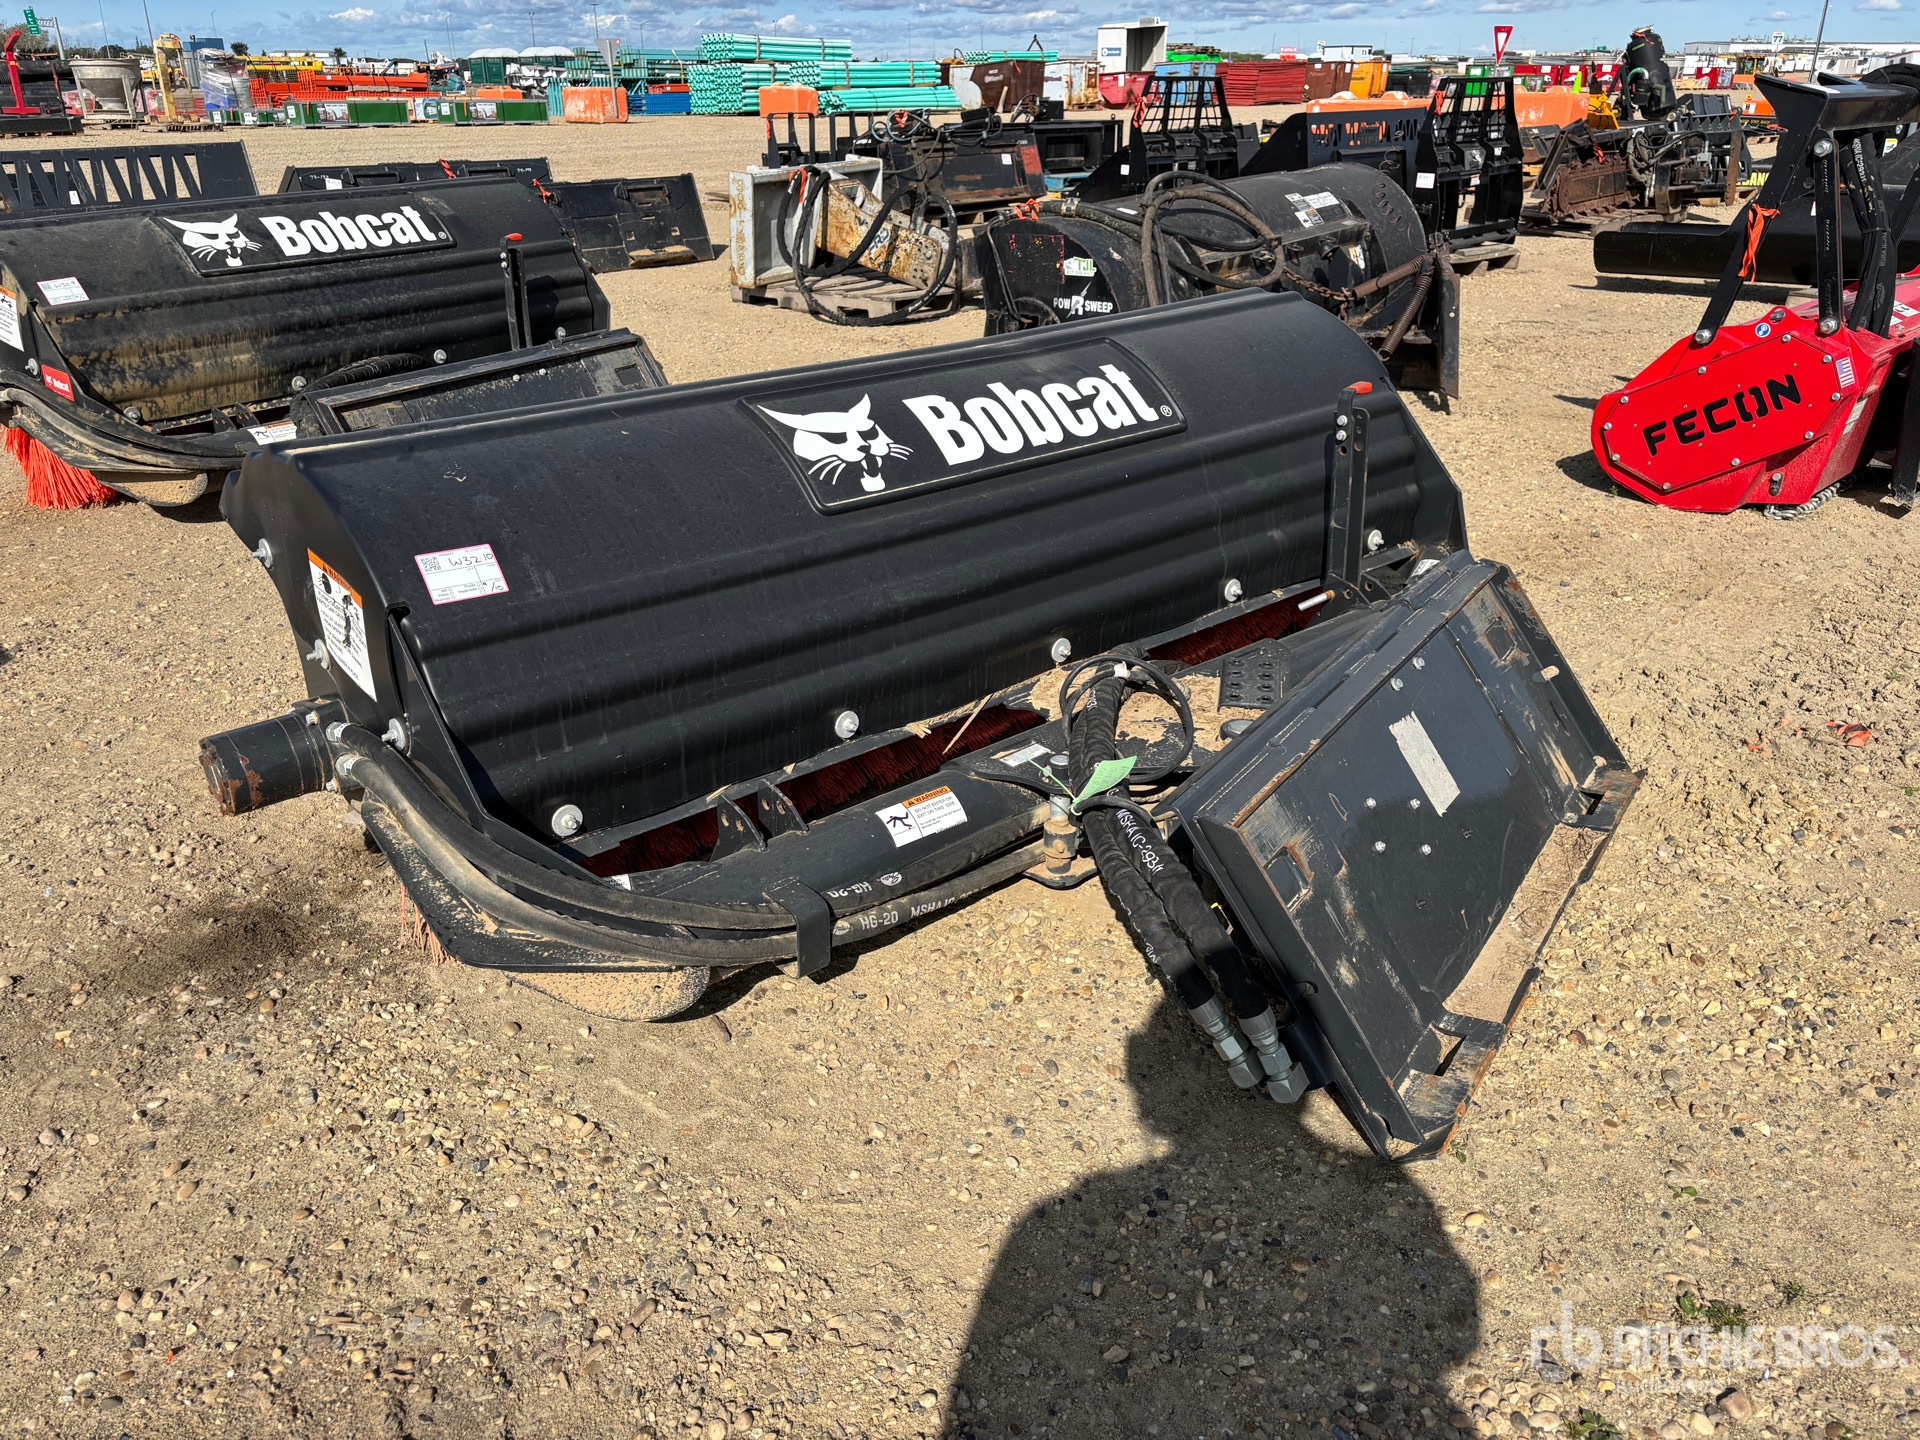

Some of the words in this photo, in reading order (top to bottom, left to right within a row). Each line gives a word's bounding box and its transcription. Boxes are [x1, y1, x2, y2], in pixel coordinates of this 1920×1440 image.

[259, 206, 437, 257] Bobcat
[1074, 258, 1096, 271] TJL
[1084, 300, 1113, 313] SWEEP
[902, 363, 1160, 466] Bobcat
[1642, 373, 1802, 457] FECON
[914, 787, 948, 803] WARNING
[1115, 808, 1138, 839] MSHA
[859, 911, 899, 930] HG-20
